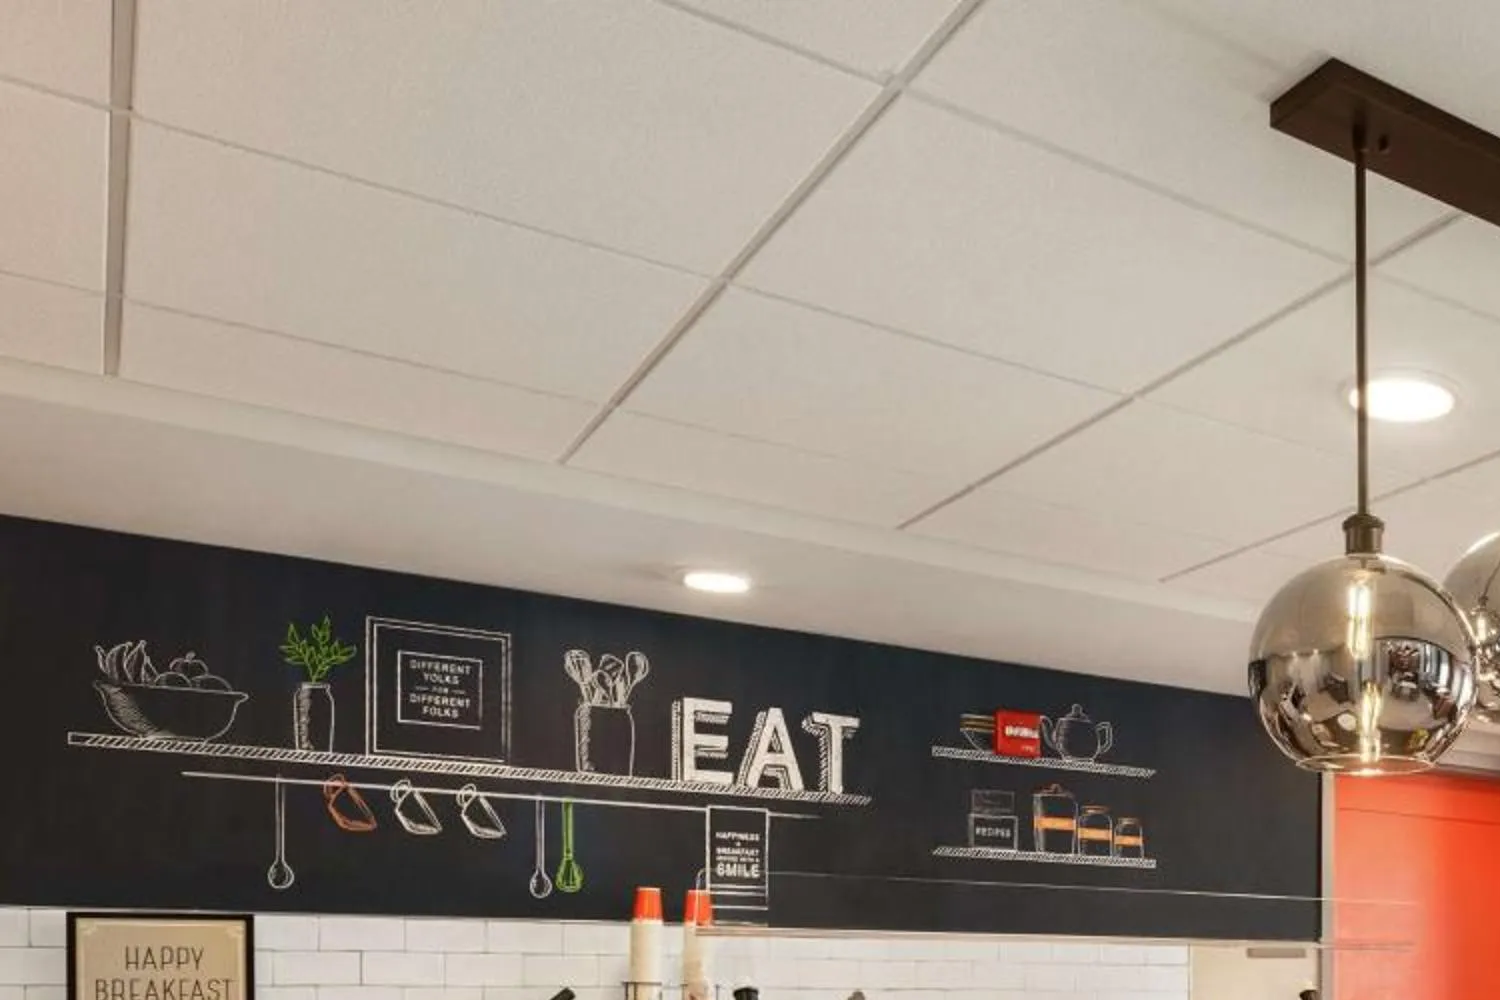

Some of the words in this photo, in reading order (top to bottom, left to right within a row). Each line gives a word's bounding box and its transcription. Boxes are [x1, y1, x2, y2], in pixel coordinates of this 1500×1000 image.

[409, 659, 471, 675] DIFFERENT
[423, 672, 459, 684] YOLKS
[409, 693, 471, 708] DIFFERENT
[422, 705, 459, 718] FOLKS
[672, 697, 861, 795] EAT
[715, 831, 760, 841] HAPPINESS
[975, 826, 1013, 839] RECIPES
[715, 847, 760, 856] BREAKFAST
[716, 862, 760, 878] SMILE
[125, 946, 204, 971] HAPPY
